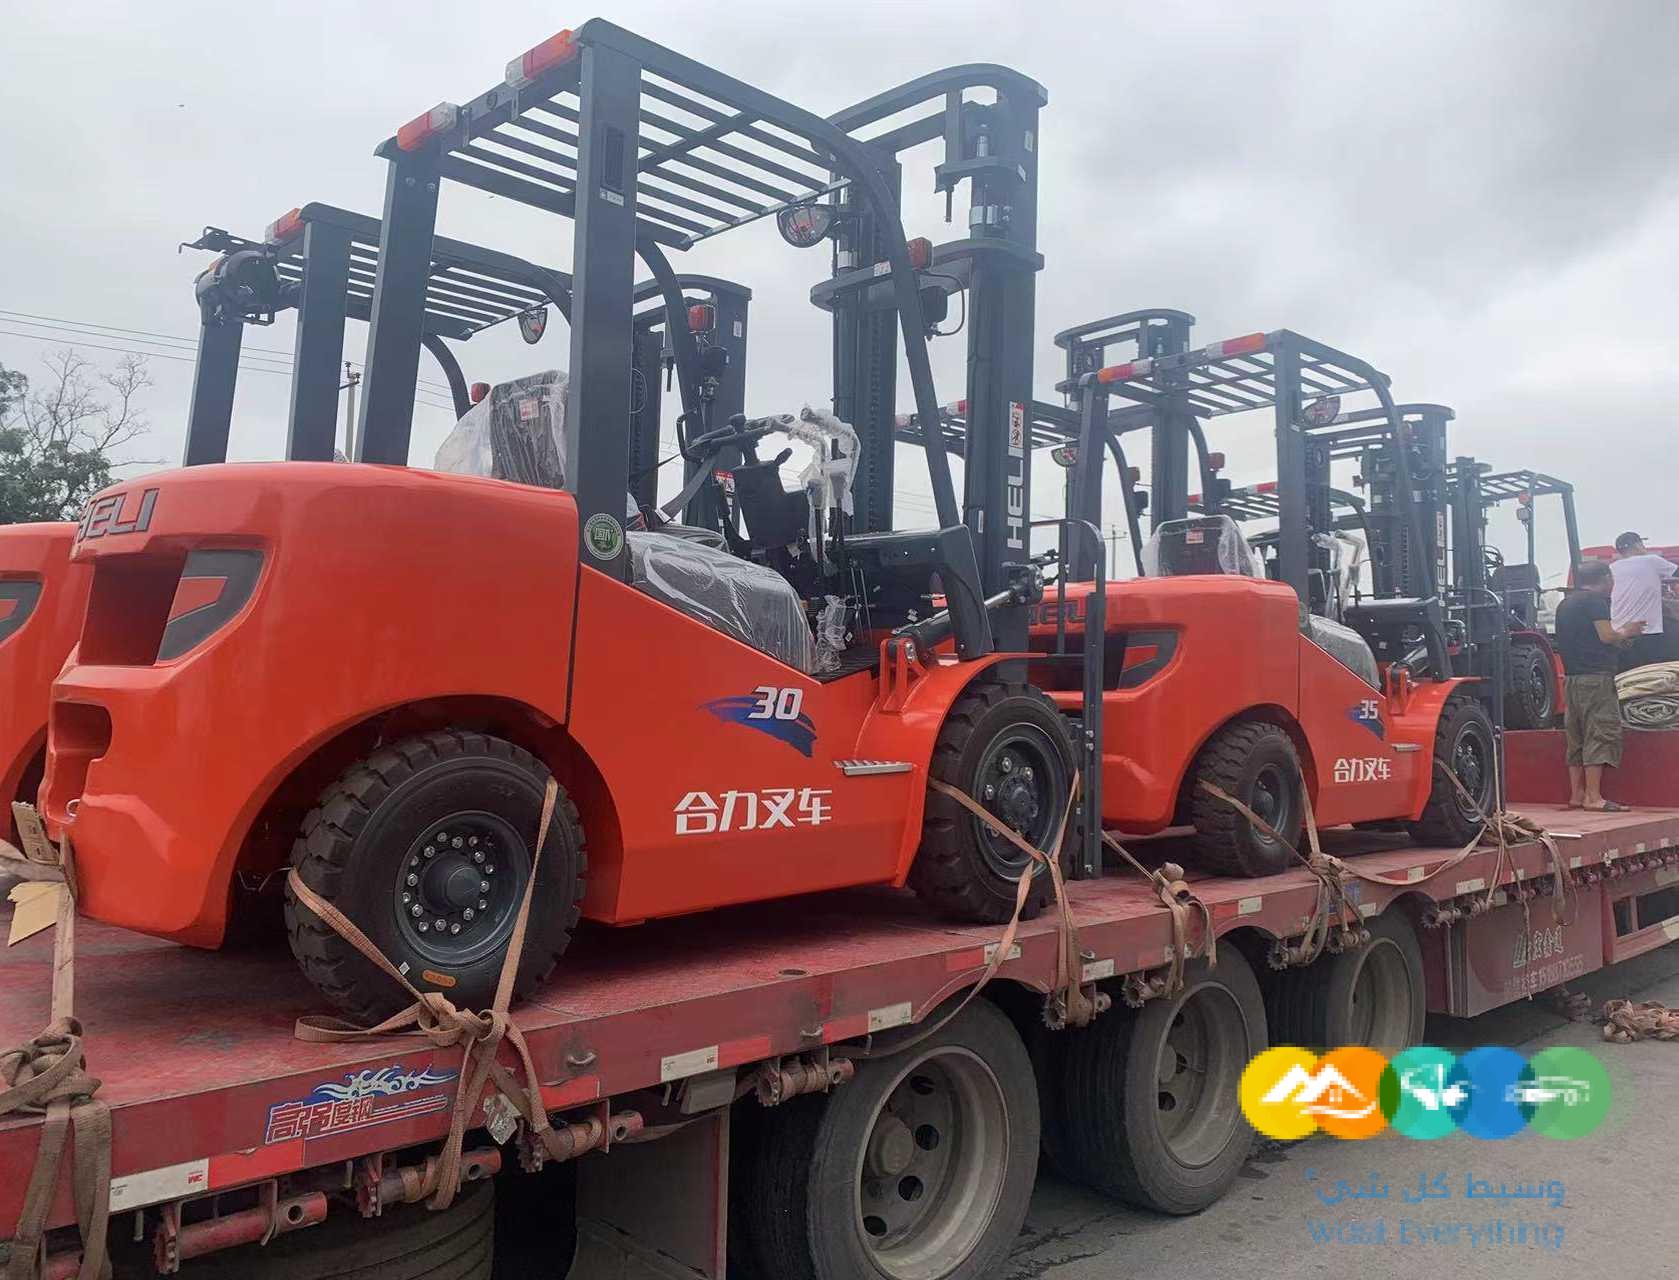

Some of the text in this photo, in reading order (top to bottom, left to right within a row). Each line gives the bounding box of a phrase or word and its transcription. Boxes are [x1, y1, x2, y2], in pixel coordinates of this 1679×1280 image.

[1007, 446, 1024, 549] HELI
[748, 685, 804, 721] 30
[1359, 699, 1379, 720] 35
[1333, 757, 1392, 784] 合力叉车
[672, 787, 833, 836] 合力叉车
